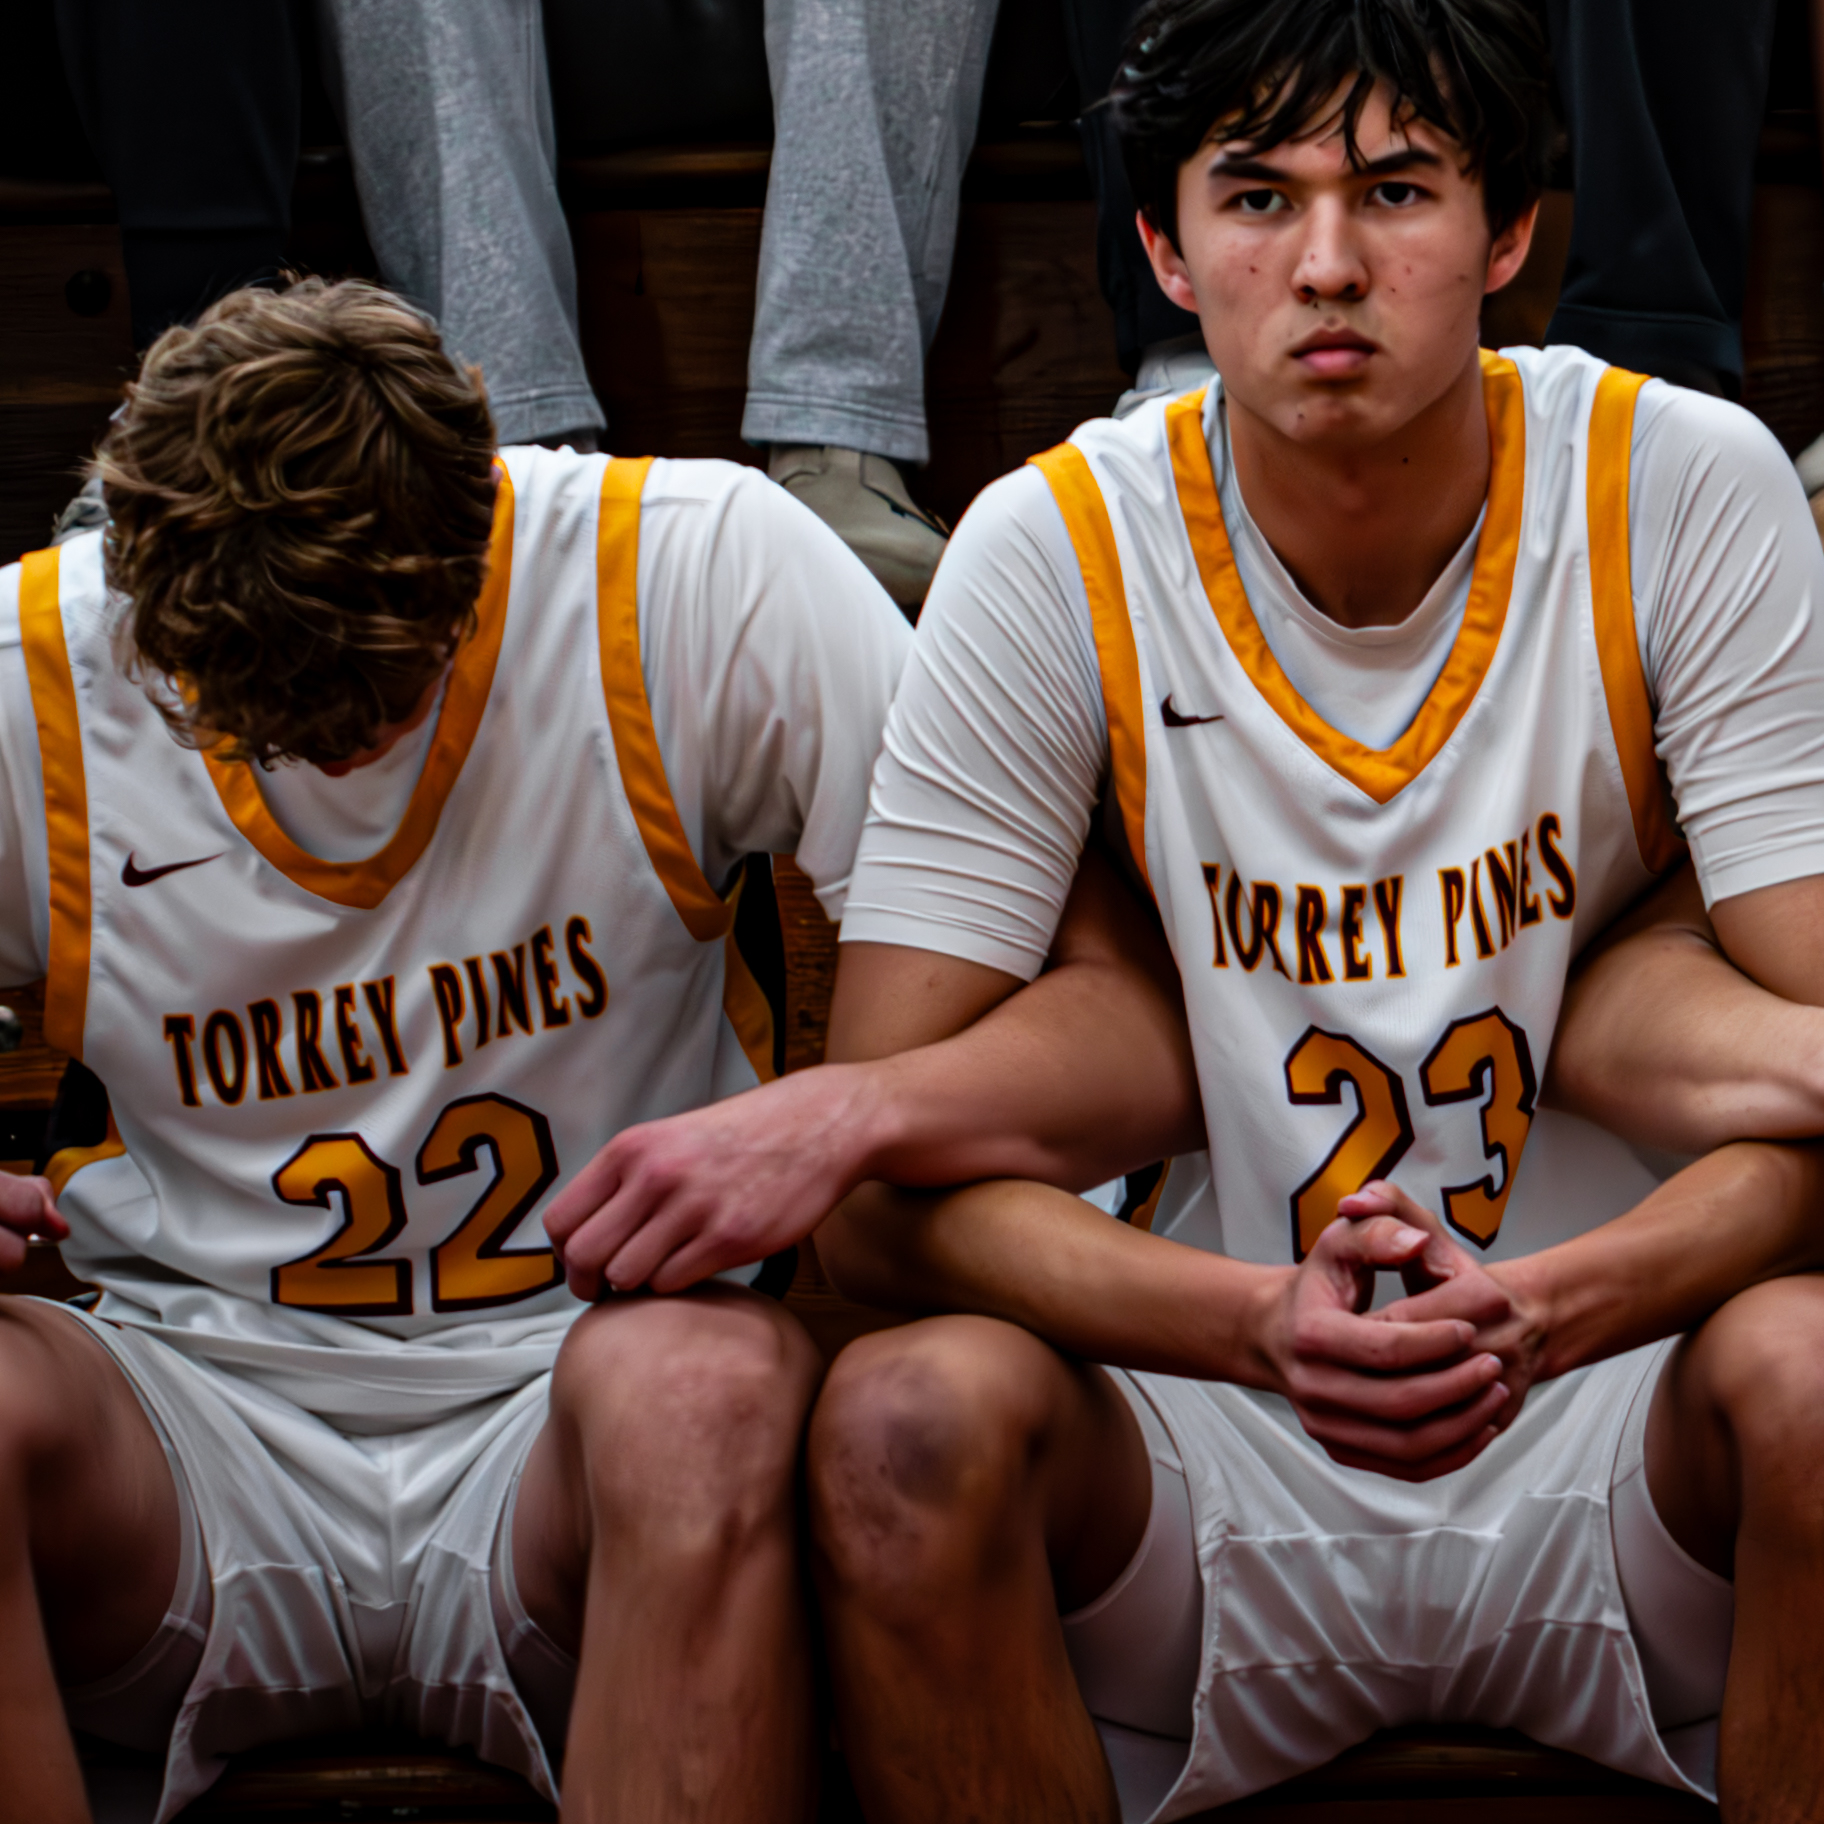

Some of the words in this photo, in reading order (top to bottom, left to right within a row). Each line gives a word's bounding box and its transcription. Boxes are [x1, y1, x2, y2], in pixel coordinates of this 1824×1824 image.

[1201, 861, 1408, 986] TORREY
[1437, 811, 1577, 970] PINES
[163, 974, 410, 1108] TORREY
[427, 914, 609, 1070] PINES
[270, 1090, 567, 1317] 22
[1284, 1004, 1539, 1266] 23
